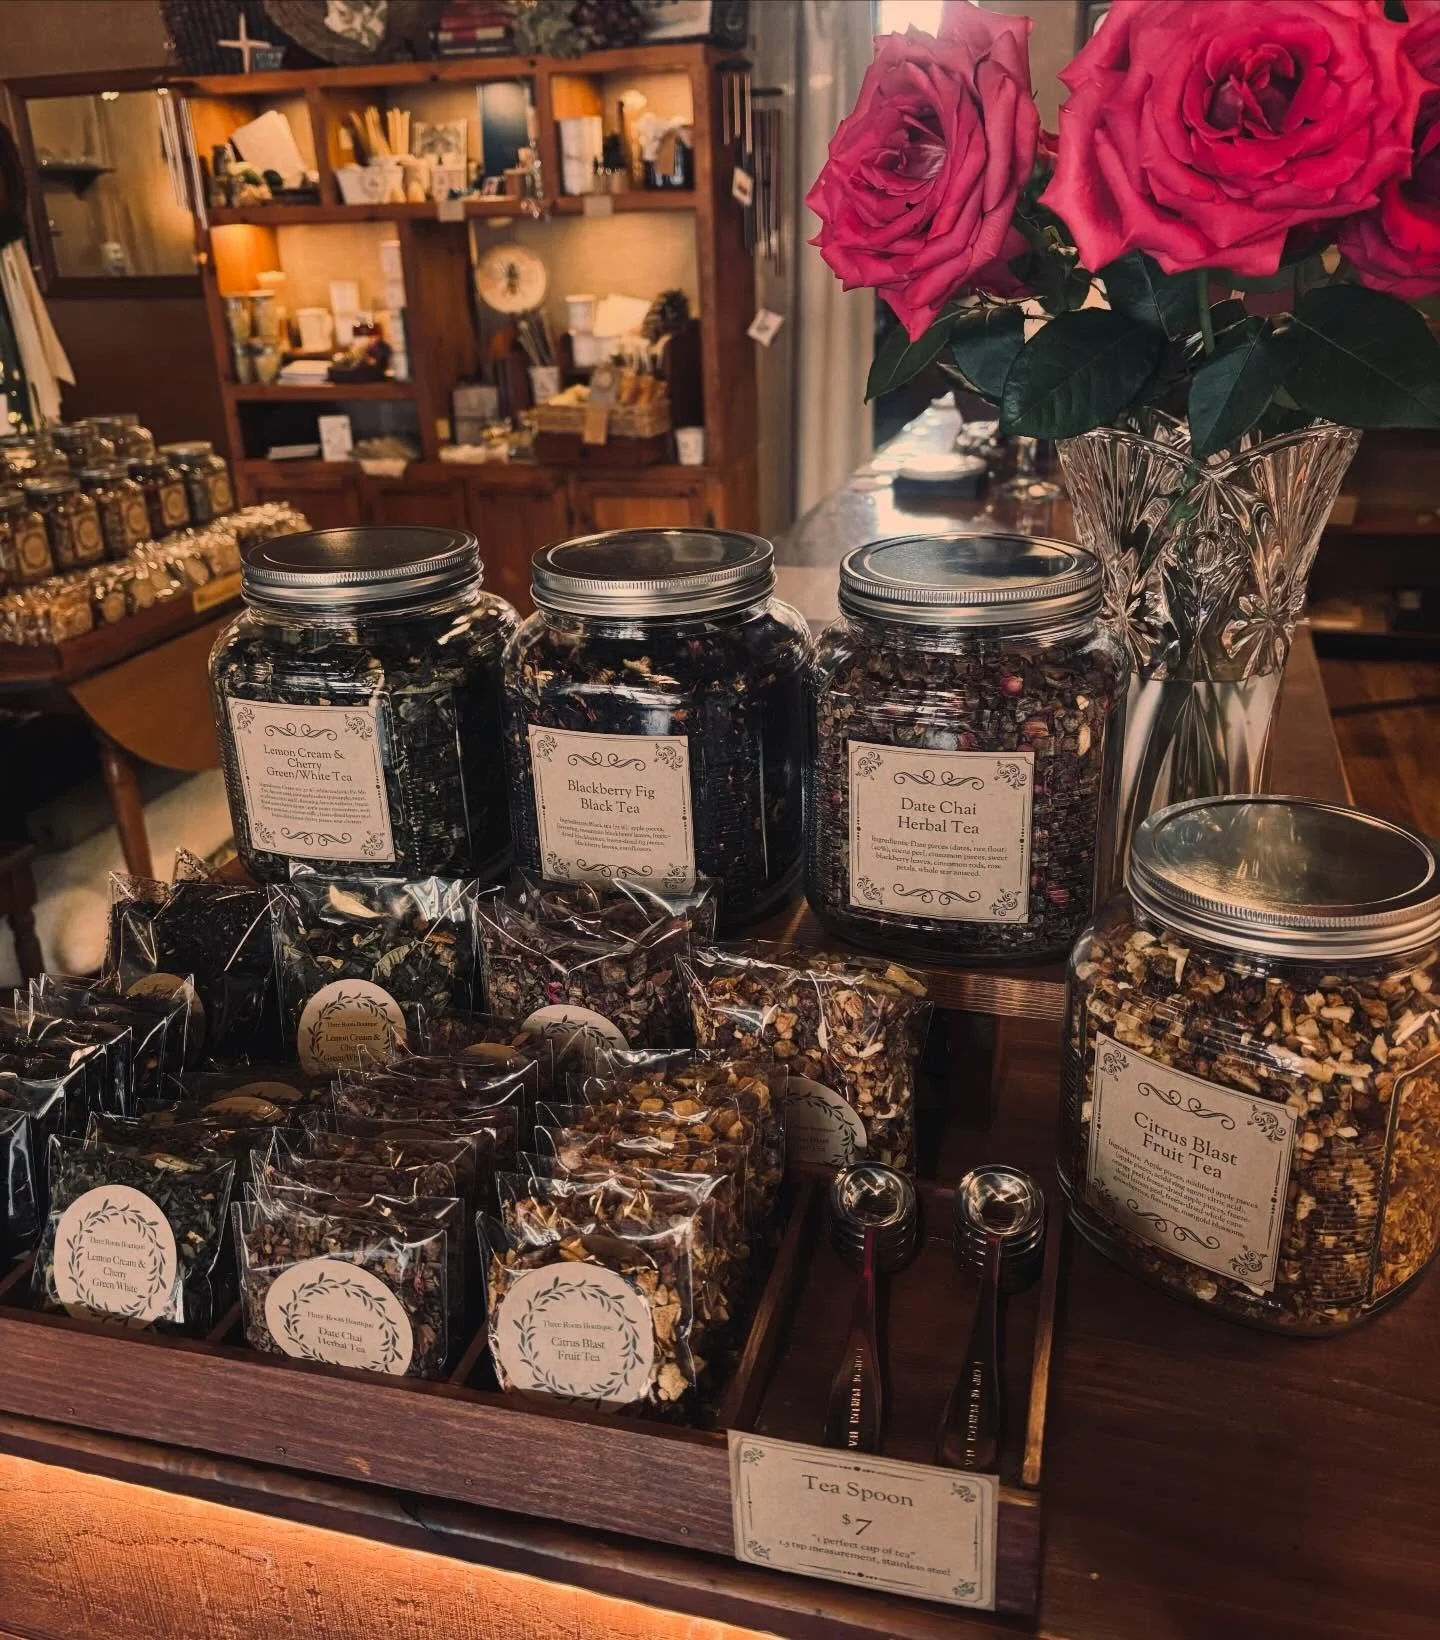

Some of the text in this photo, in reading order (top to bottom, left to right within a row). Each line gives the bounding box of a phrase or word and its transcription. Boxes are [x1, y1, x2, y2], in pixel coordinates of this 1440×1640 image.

[264, 745, 344, 759] Lemon Cream &
[288, 758, 322, 770] Cherry
[266, 768, 352, 782] Green/White Tea
[568, 780, 655, 799] Blackberry Fig
[581, 798, 640, 814] Black Tea
[901, 798, 977, 815] Date Chai
[897, 816, 979, 834] Herbal Tea
[1134, 1112, 1238, 1166] Citrus Blast
[1142, 1132, 1223, 1180] Fruit Tea
[1144, 1160, 1162, 1172] Apple
[1216, 1191, 1236, 1202] apple
[87, 1252, 146, 1268] Lemon Cream &
[103, 1267, 127, 1278] Cherry
[319, 1327, 362, 1342] Date Chai
[551, 1336, 606, 1349] Citrus Blast
[317, 1337, 366, 1353] Herbal Tea
[558, 1351, 601, 1362] Fruit Tea
[802, 1474, 914, 1507] Tea Spoon
[841, 1514, 872, 1536] $7
[823, 1537, 858, 1550] perfect
[860, 1543, 880, 1554] cup
[881, 1546, 893, 1555] of
[792, 1542, 807, 1552] tsp
[808, 1545, 880, 1564] measurement,
[882, 1557, 926, 1571] stainless
[927, 1566, 952, 1577] steel
